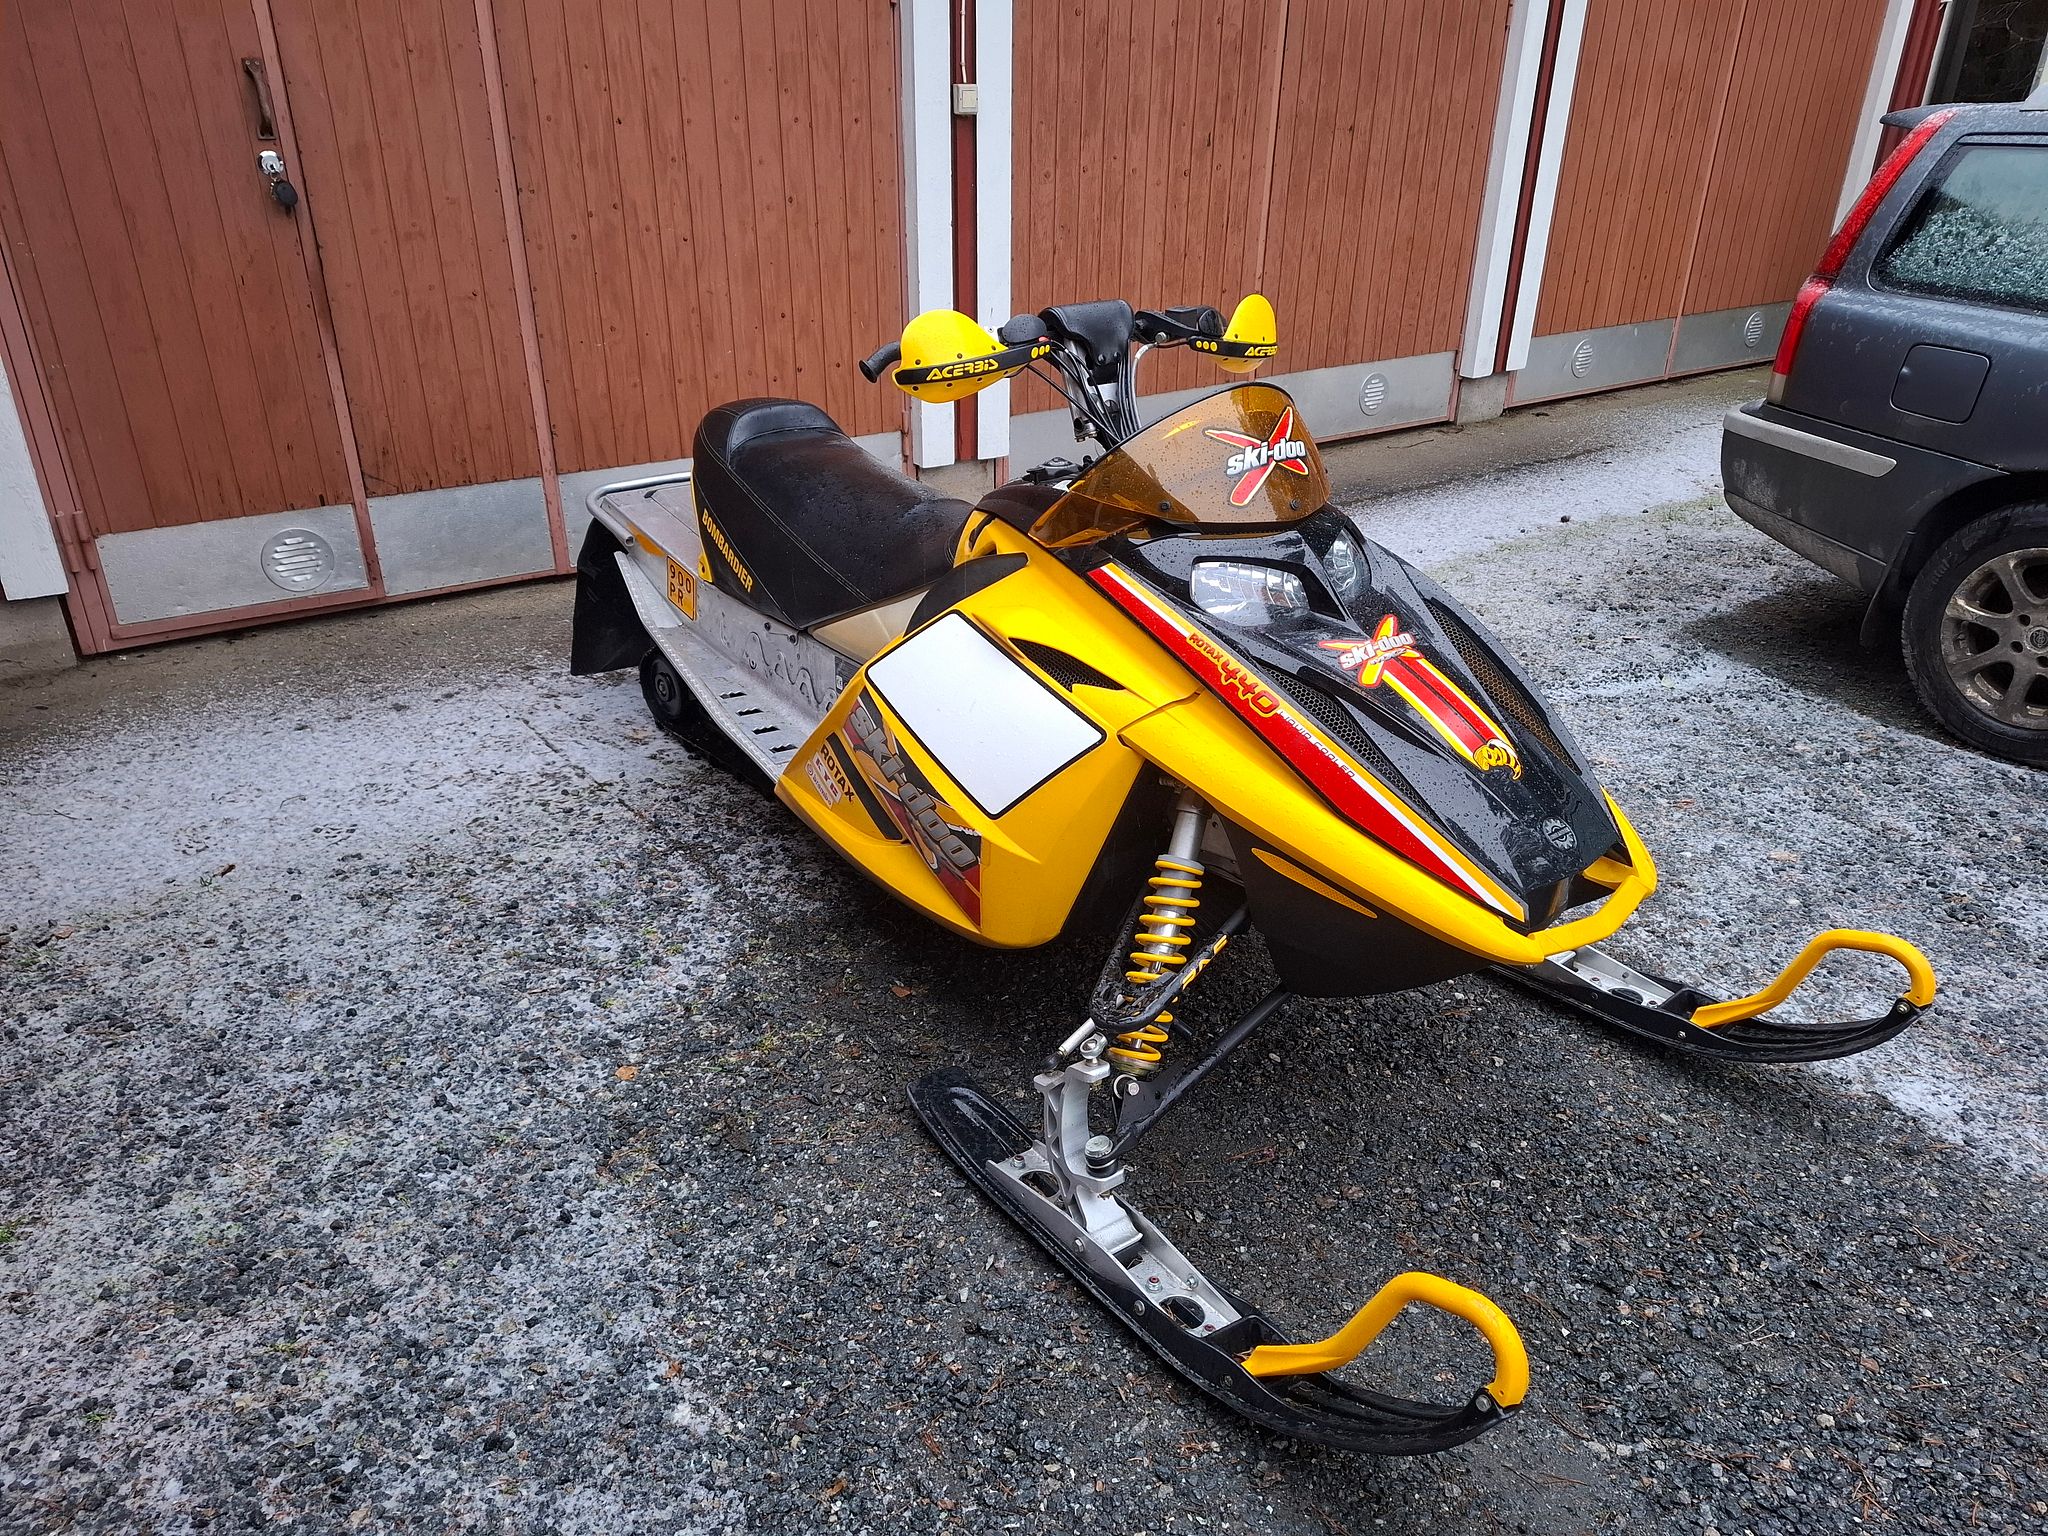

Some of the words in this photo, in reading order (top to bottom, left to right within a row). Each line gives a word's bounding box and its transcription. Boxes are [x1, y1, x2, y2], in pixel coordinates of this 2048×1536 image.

[1226, 438, 1306, 475] ski-doo
[702, 508, 753, 593] BOMBARDIER
[670, 565, 692, 594] 900
[670, 582, 683, 606] PR
[1339, 633, 1414, 669] ski-doo
[1189, 633, 1224, 662] ROTAX
[1221, 659, 1280, 714] 440
[1279, 710, 1312, 739] LIQUID
[1314, 741, 1355, 777] COOLED
[820, 744, 855, 802] ROTAX
